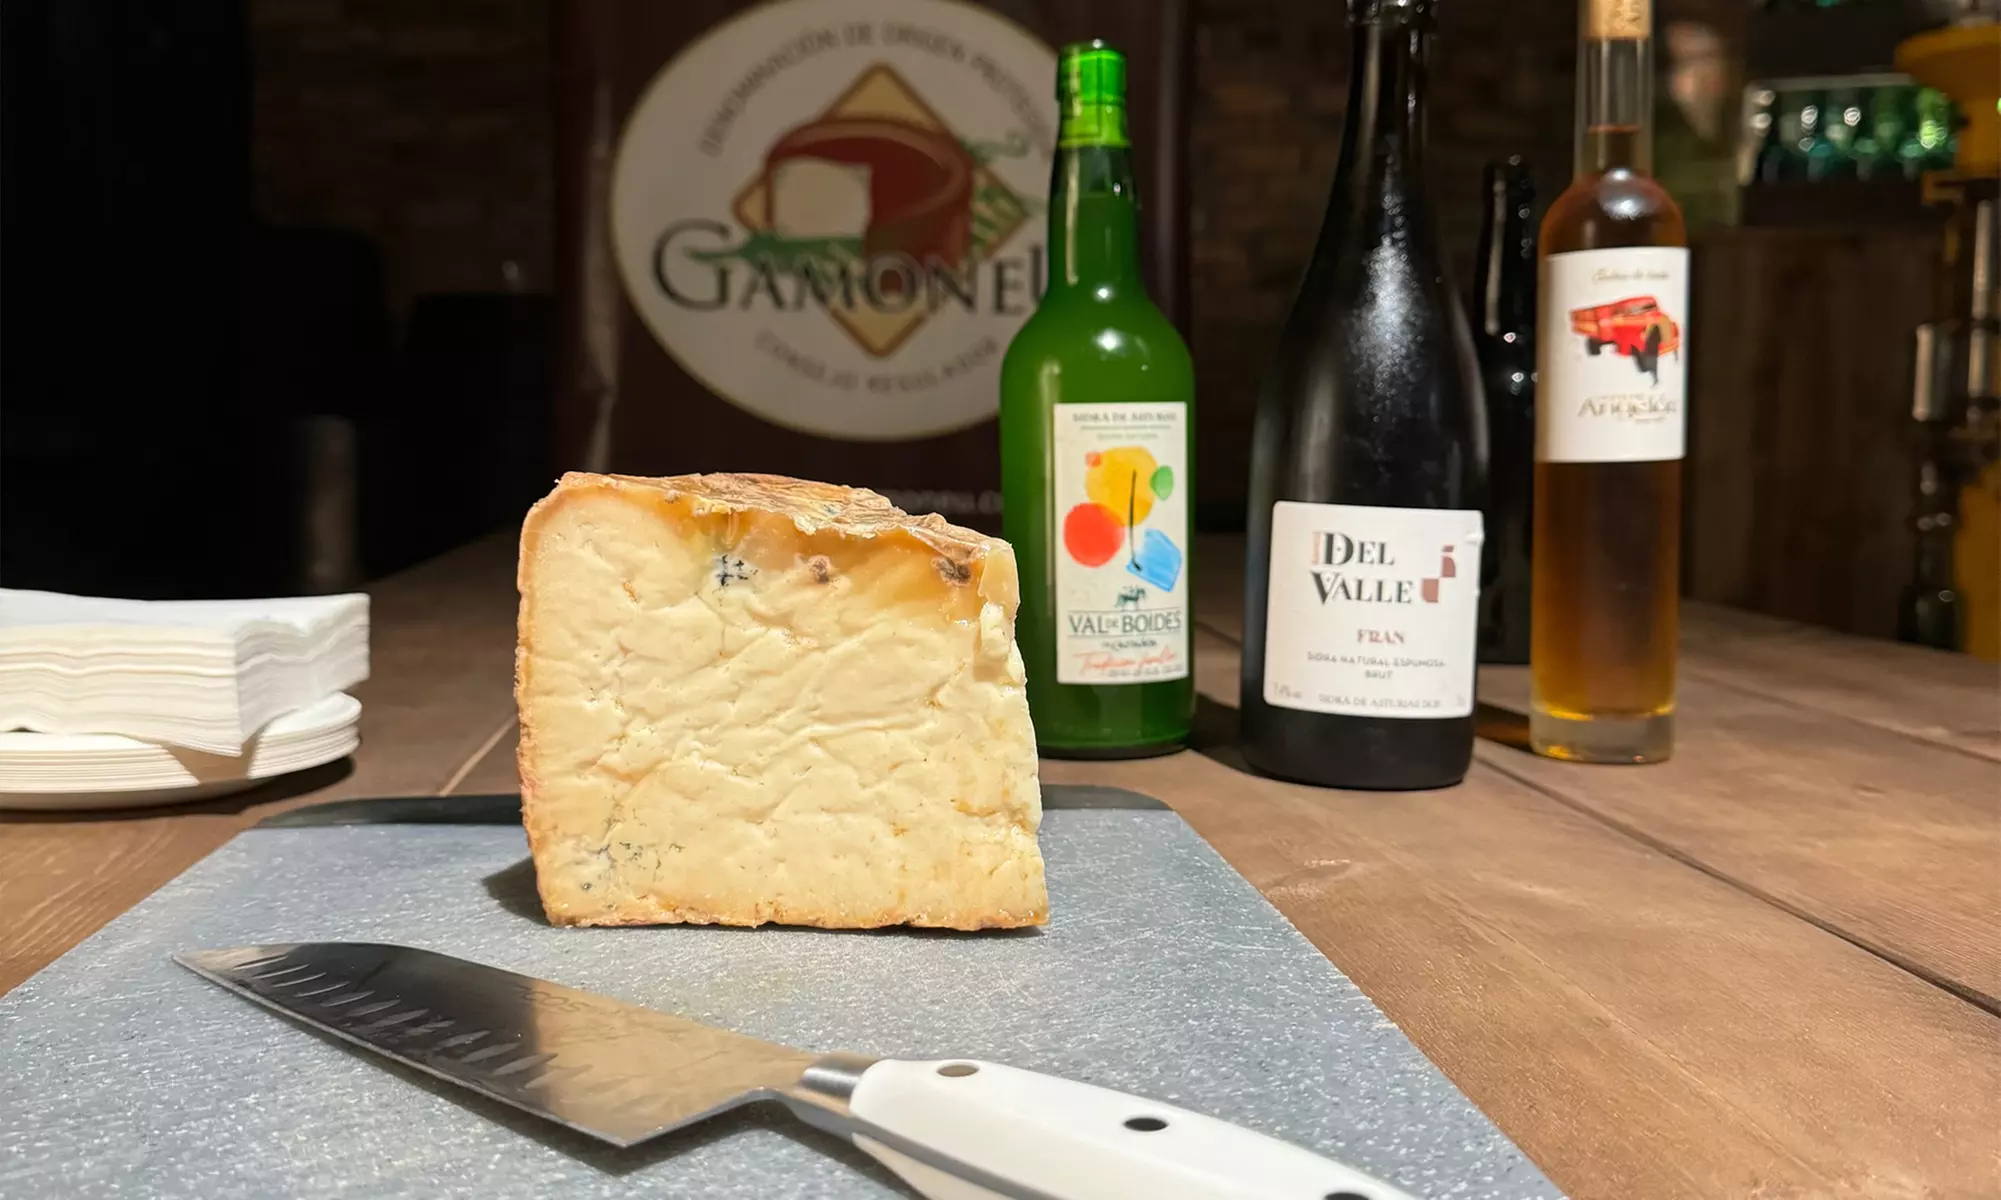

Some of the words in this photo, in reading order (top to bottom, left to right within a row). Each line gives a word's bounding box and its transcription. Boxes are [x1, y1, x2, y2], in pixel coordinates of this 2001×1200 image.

[1323, 532, 1395, 566] DEL
[1310, 570, 1414, 605] VALLE
[1068, 614, 1109, 634] VAL
[1122, 611, 1182, 633] BOIDES
[1357, 629, 1405, 644] FRAN
[1308, 651, 1337, 663] SIDRA
[1340, 654, 1390, 667] NATURAL
[1365, 670, 1393, 680] BRUT
